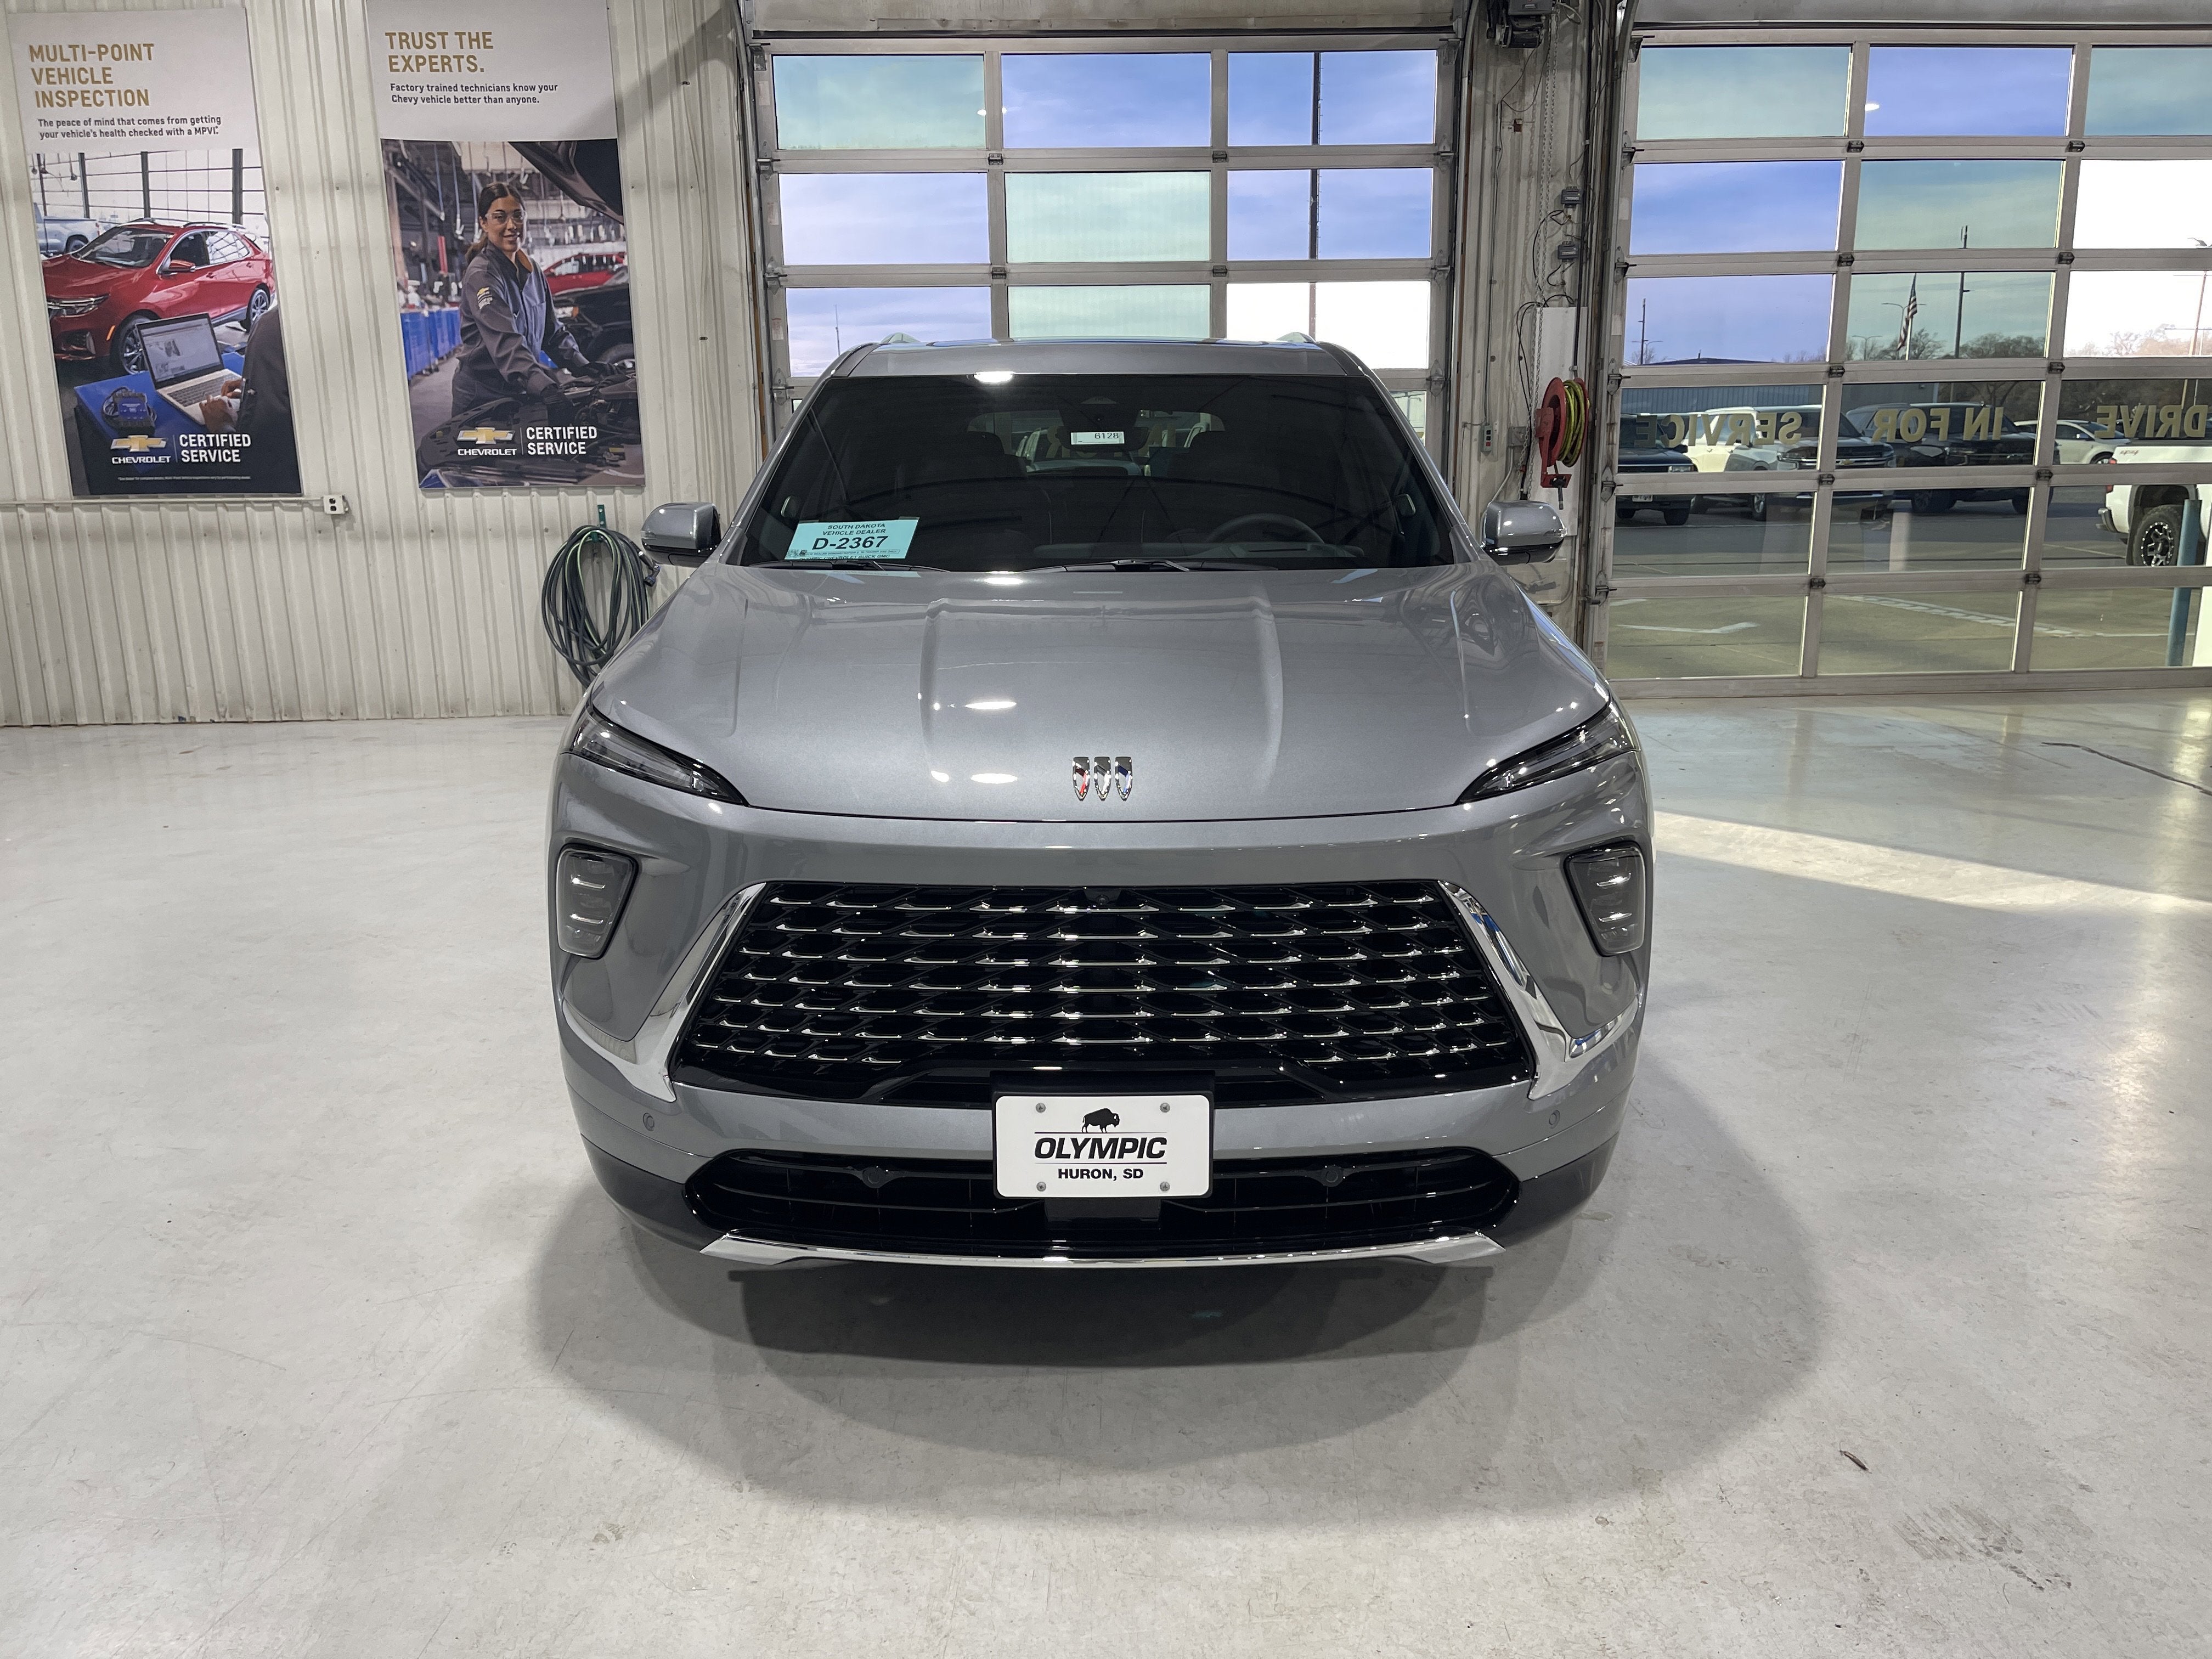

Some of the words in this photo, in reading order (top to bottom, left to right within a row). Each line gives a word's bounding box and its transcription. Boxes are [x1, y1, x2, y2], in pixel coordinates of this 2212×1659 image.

[385, 31, 448, 50] TRUST
[454, 31, 494, 50] THE
[29, 43, 154, 63] MULTI-POINT
[388, 55, 484, 73] EXPERTS.
[32, 66, 113, 86] VEHICLE
[390, 83, 424, 93] Factory
[427, 83, 458, 92] trained
[460, 83, 510, 92] technicians
[513, 83, 536, 92] know
[538, 84, 558, 93] your
[35, 88, 150, 108] INSPECTION
[392, 94, 418, 105] Chevy
[421, 95, 451, 103] vehicle
[454, 95, 481, 104] better
[506, 97, 540, 105] anyone.
[38, 119, 53, 127] The
[56, 120, 81, 128] peace
[83, 118, 92, 126] of
[117, 117, 135, 126] that
[190, 115, 221, 126] getting
[40, 132, 59, 140] your
[61, 129, 97, 138] vehicle's
[99, 129, 126, 137] health
[128, 128, 163, 137] checked
[526, 426, 597, 439] CERTIFIED
[179, 434, 251, 447] CERTIFIED
[527, 442, 586, 455] SERVICE
[111, 456, 171, 464] CHEVROLET
[181, 449, 241, 462] SERVICE
[812, 535, 889, 550] D-2367
[1035, 1137, 1167, 1160] OLYMPIC
[1058, 1168, 1117, 1181] HURON,
[1123, 1168, 1144, 1179] SD
